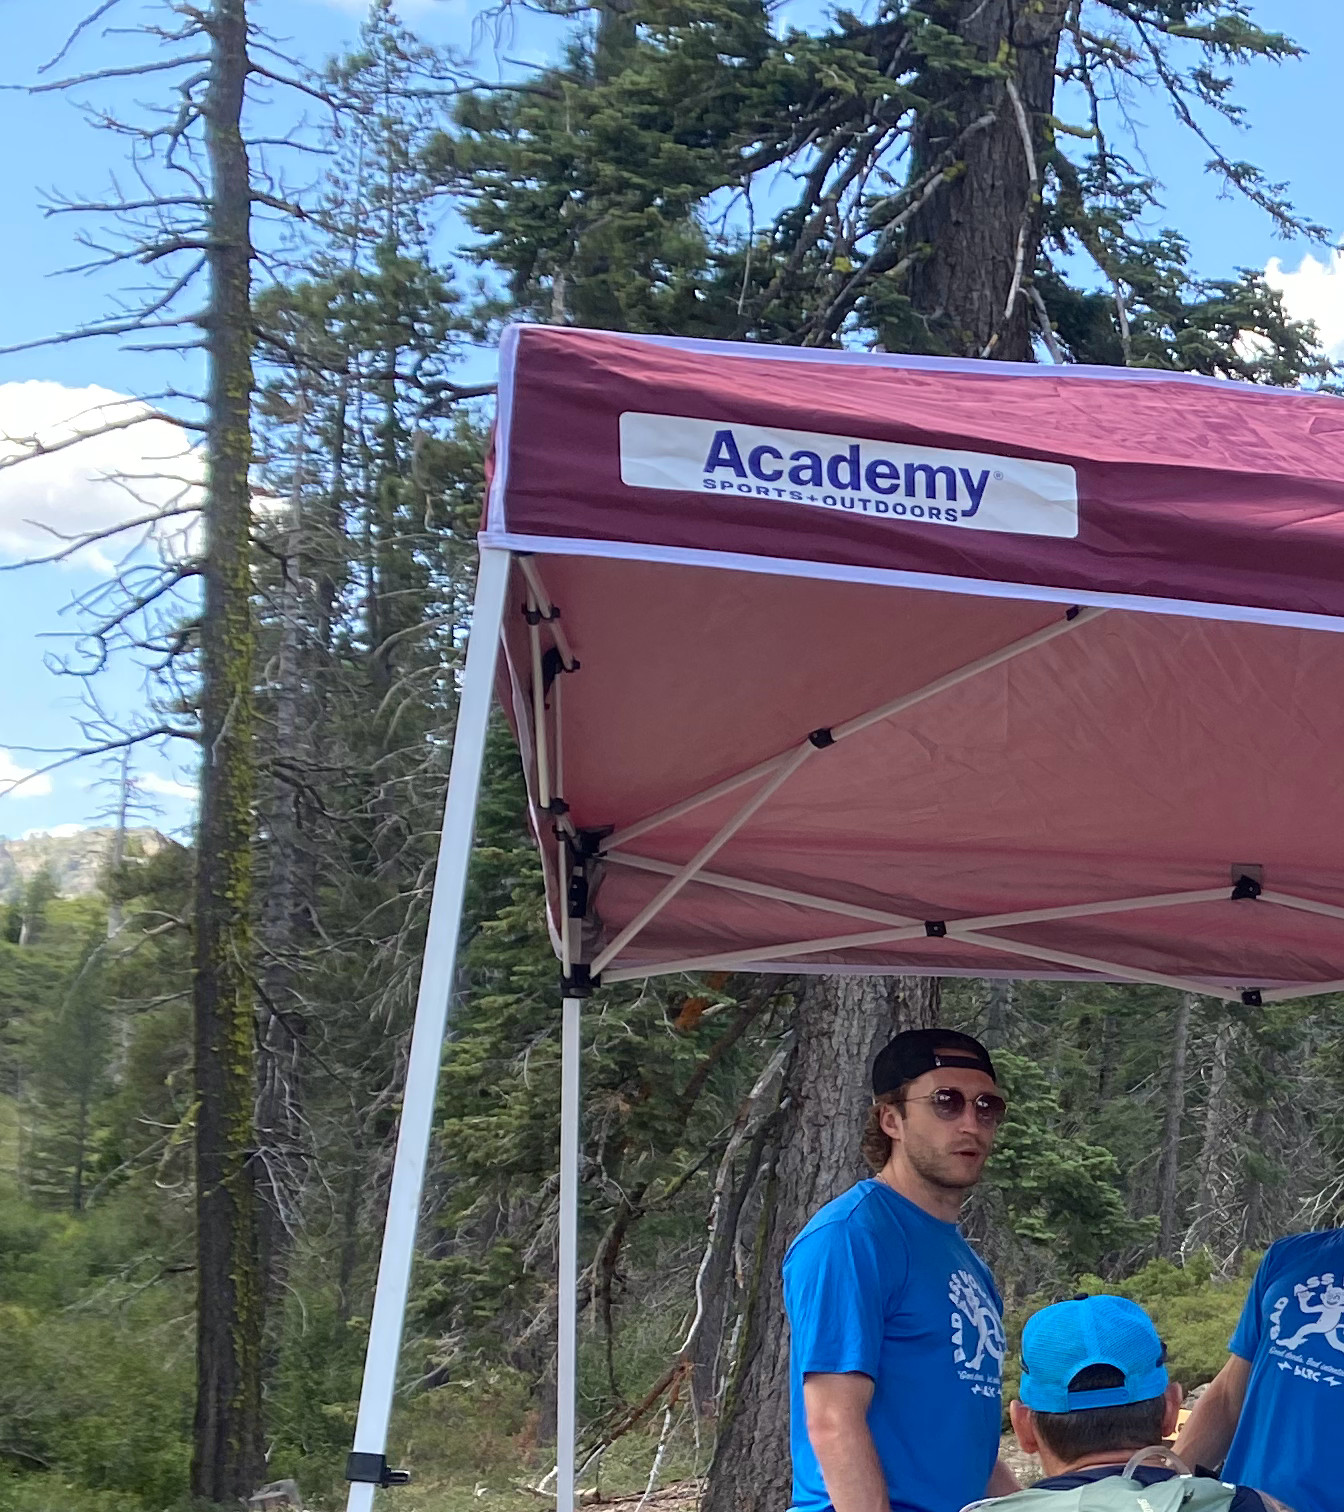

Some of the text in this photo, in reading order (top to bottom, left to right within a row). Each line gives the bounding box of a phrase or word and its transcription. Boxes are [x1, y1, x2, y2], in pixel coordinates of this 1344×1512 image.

[703, 430, 991, 517] Academy
[702, 478, 959, 522] SPORTS+OUTDOORS
[1294, 1272, 1335, 1297] ASS
